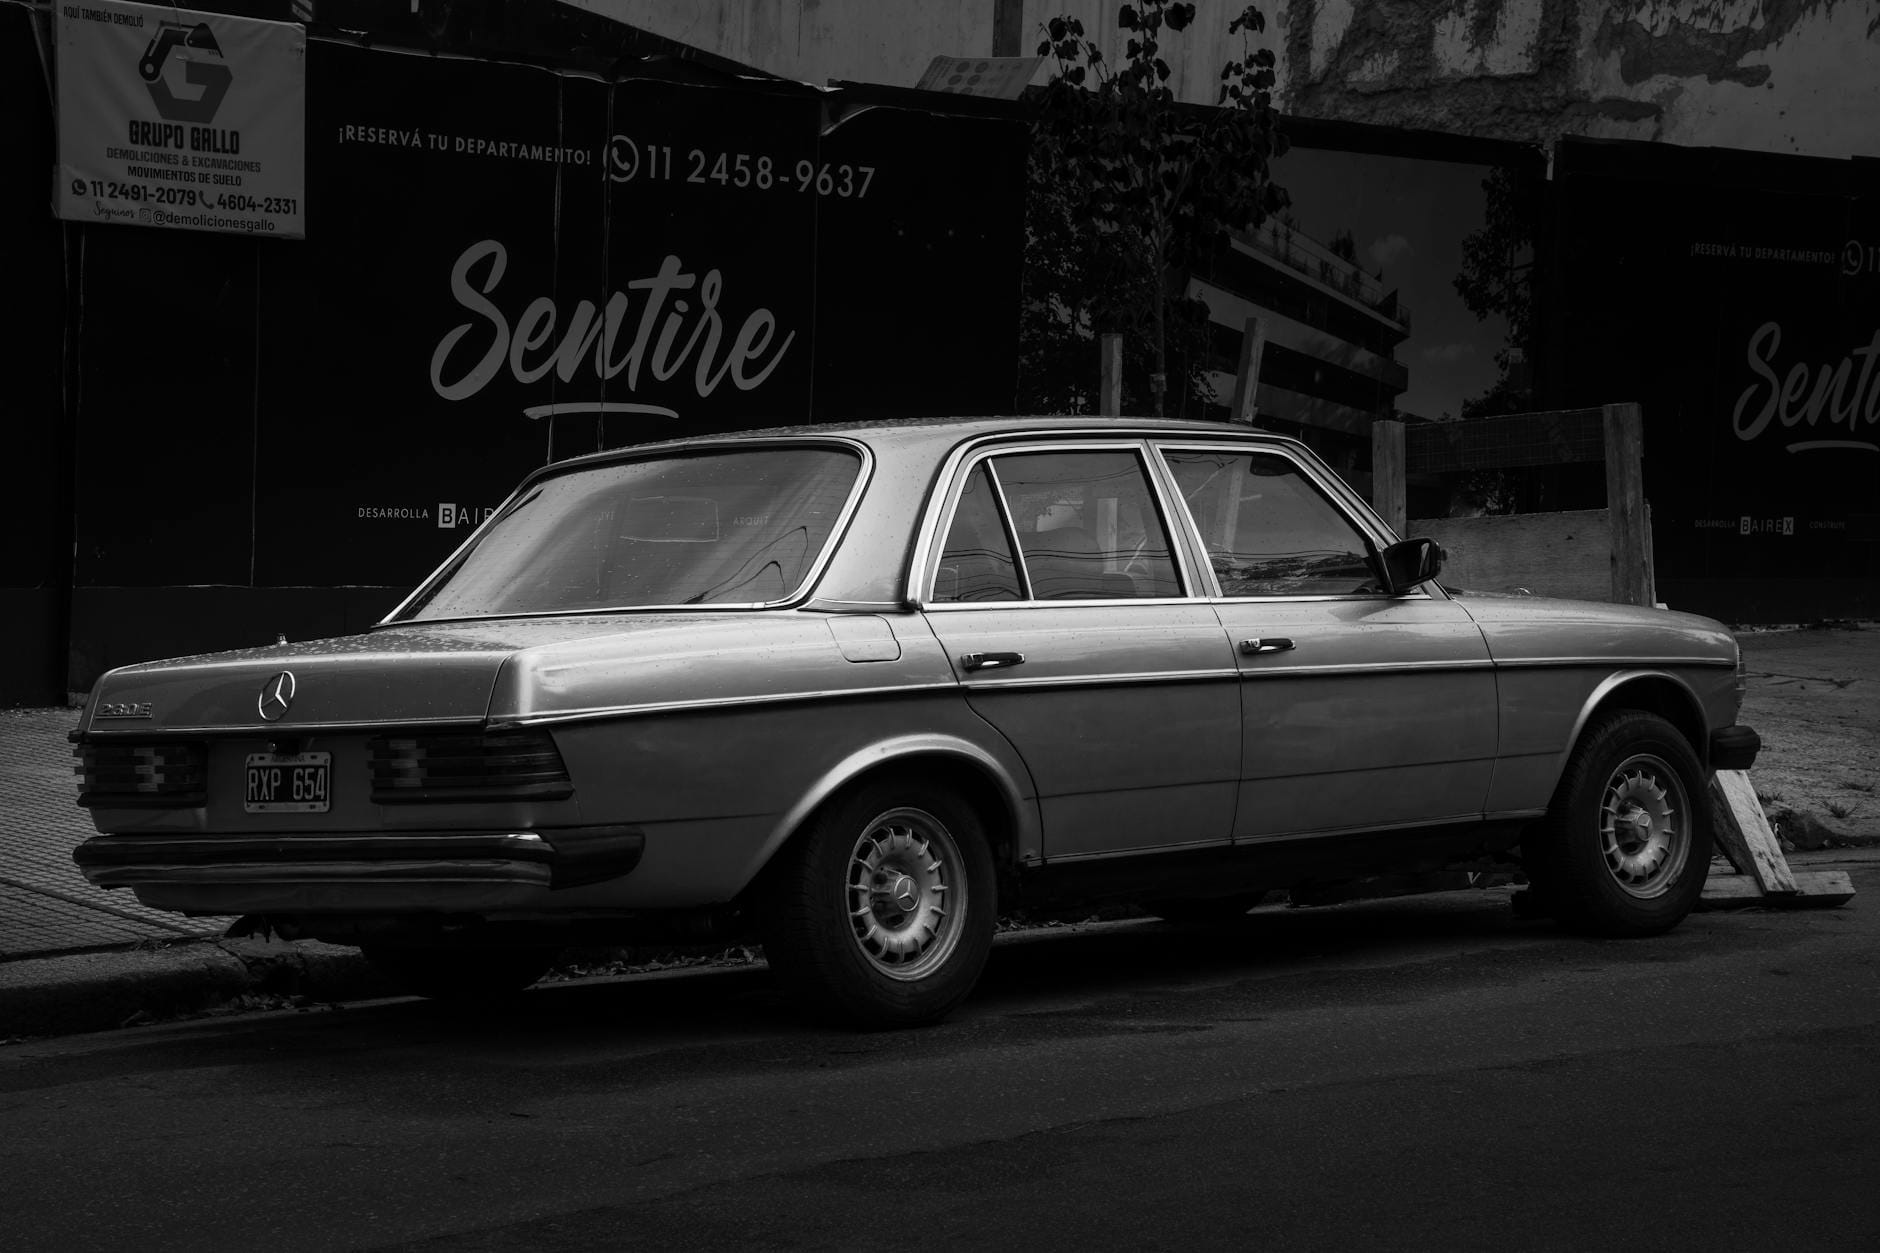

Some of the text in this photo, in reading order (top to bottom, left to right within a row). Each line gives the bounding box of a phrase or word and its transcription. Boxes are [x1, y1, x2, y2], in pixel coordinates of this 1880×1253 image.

[129, 120, 240, 154] GRUPO GALLO
[338, 124, 592, 166] ¡RESERVÁ TU DEPARTAMENTO!
[106, 147, 261, 173] DEMOLICIONES & EXCAVACIONES
[647, 144, 876, 200] 11 2458-9637
[127, 166, 242, 187] MOVIMIENTOS DE SUELO
[90, 180, 297, 215] 11 2491-2079 4604-2331
[152, 210, 275, 232] @demolicionesgallo
[1740, 246, 1752, 259] TU
[1755, 247, 1836, 264] DEPARTAMENTO!
[429, 238, 797, 402] Sentire
[358, 506, 430, 520] DESARROLLA
[1740, 515, 1795, 536] BAIREX
[247, 767, 326, 802] RXP 654
